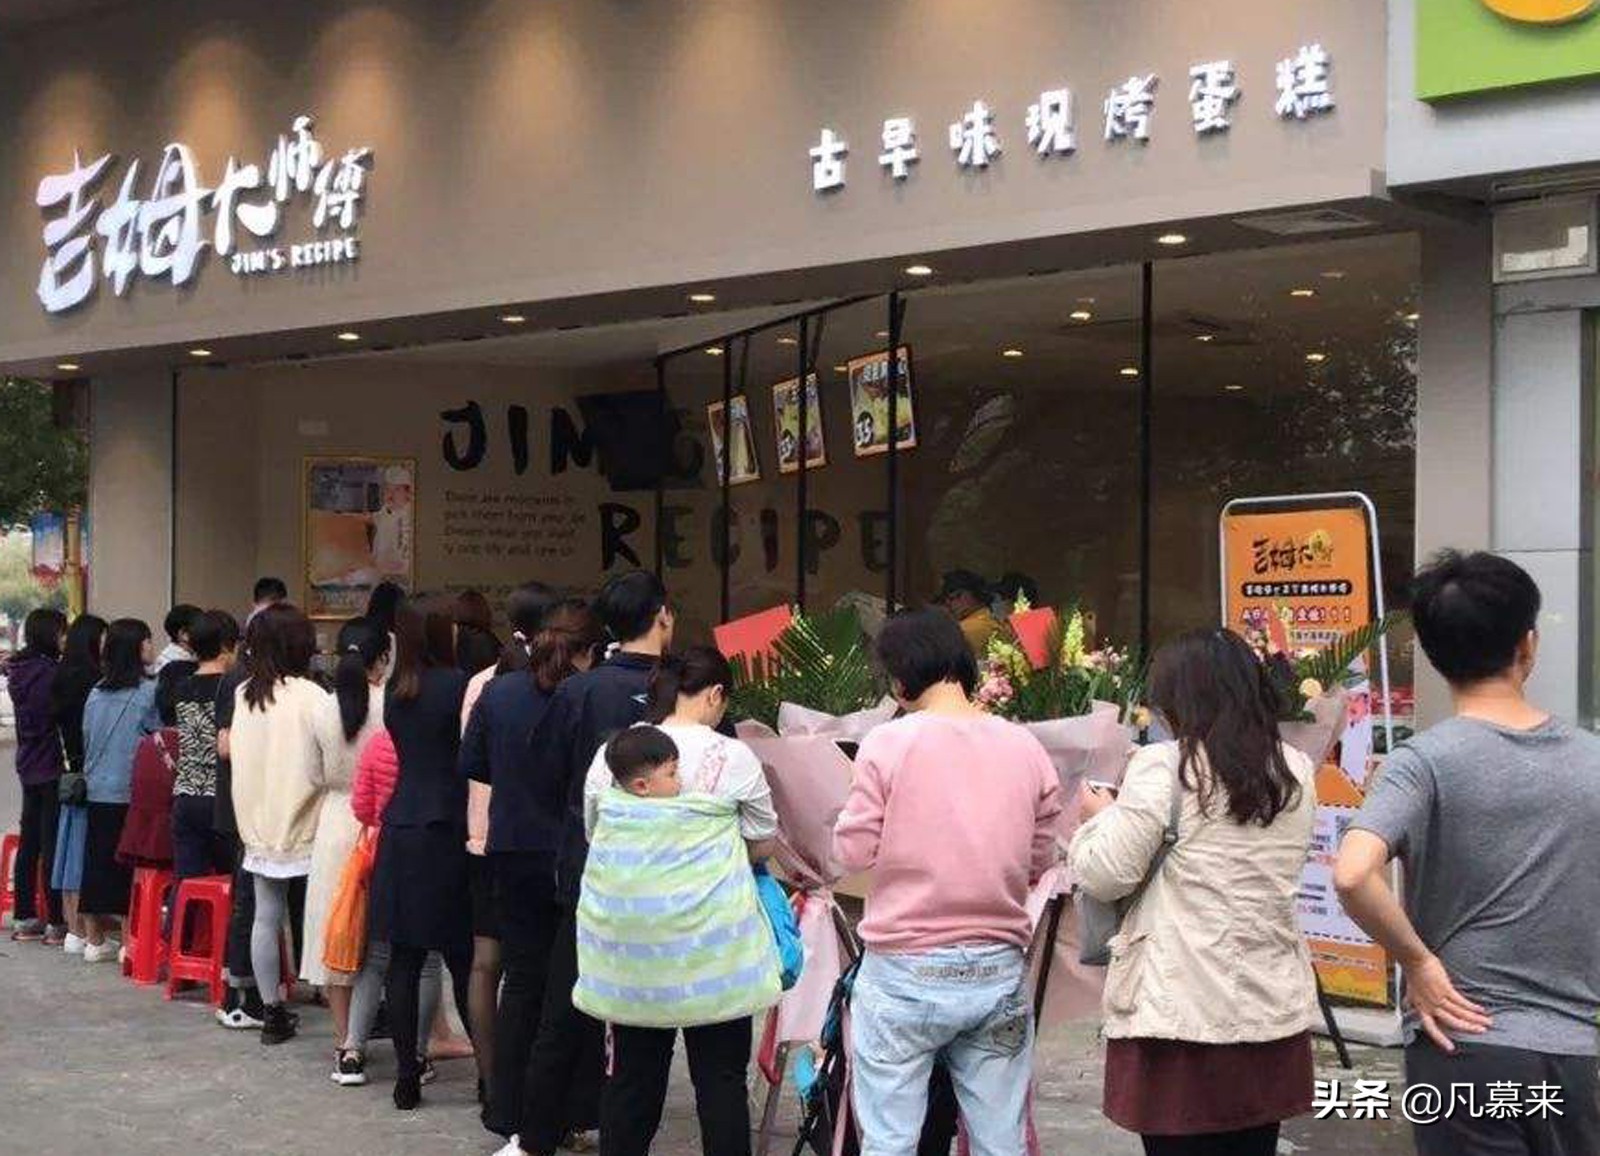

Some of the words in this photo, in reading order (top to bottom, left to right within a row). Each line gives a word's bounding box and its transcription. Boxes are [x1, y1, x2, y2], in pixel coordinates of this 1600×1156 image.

[809, 43, 1335, 191] 古早味现烤蛋糕
[36, 115, 372, 312] 吉姆大师傅
[231, 248, 285, 274] JIM'S
[290, 237, 357, 268] RECIPE
